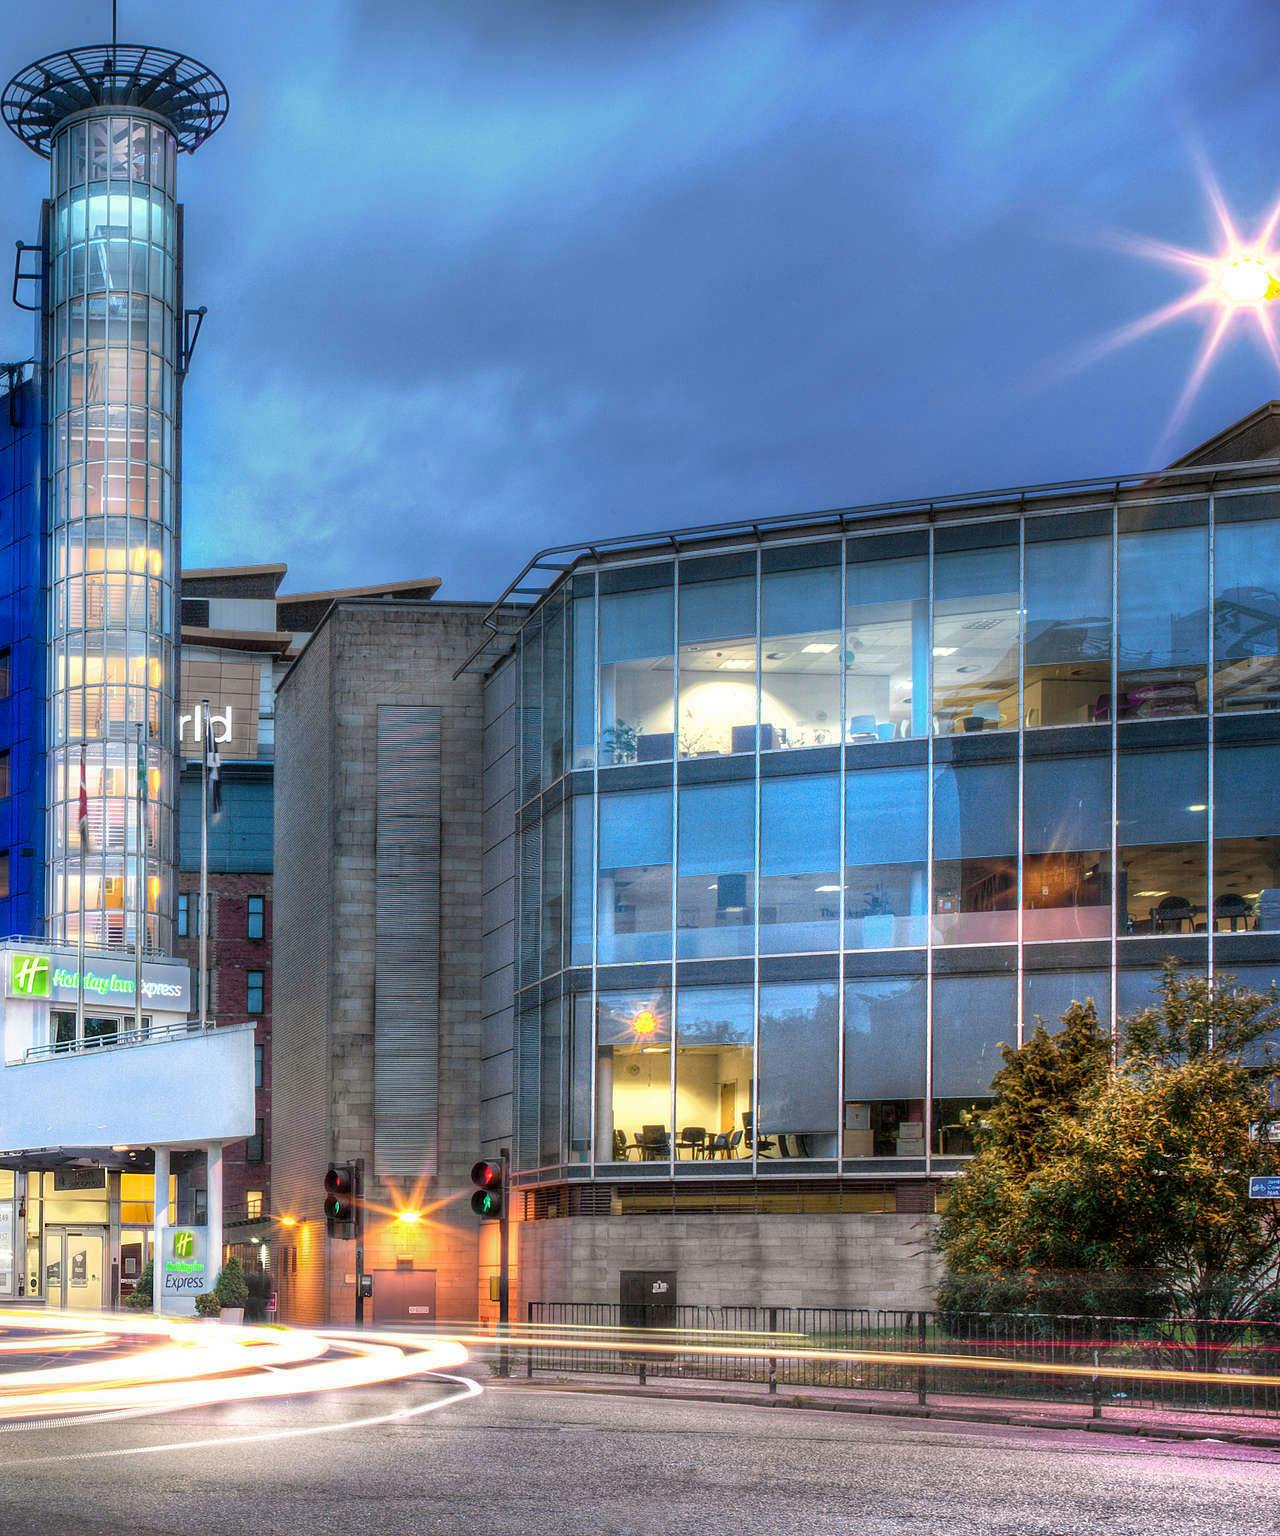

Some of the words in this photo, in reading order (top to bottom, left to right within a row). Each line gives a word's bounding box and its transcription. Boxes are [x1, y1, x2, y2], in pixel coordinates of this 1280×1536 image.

[53, 969, 109, 995] Holday
[110, 974, 135, 993] Inn
[141, 979, 182, 998] xpress
[166, 1274, 204, 1291] Express
